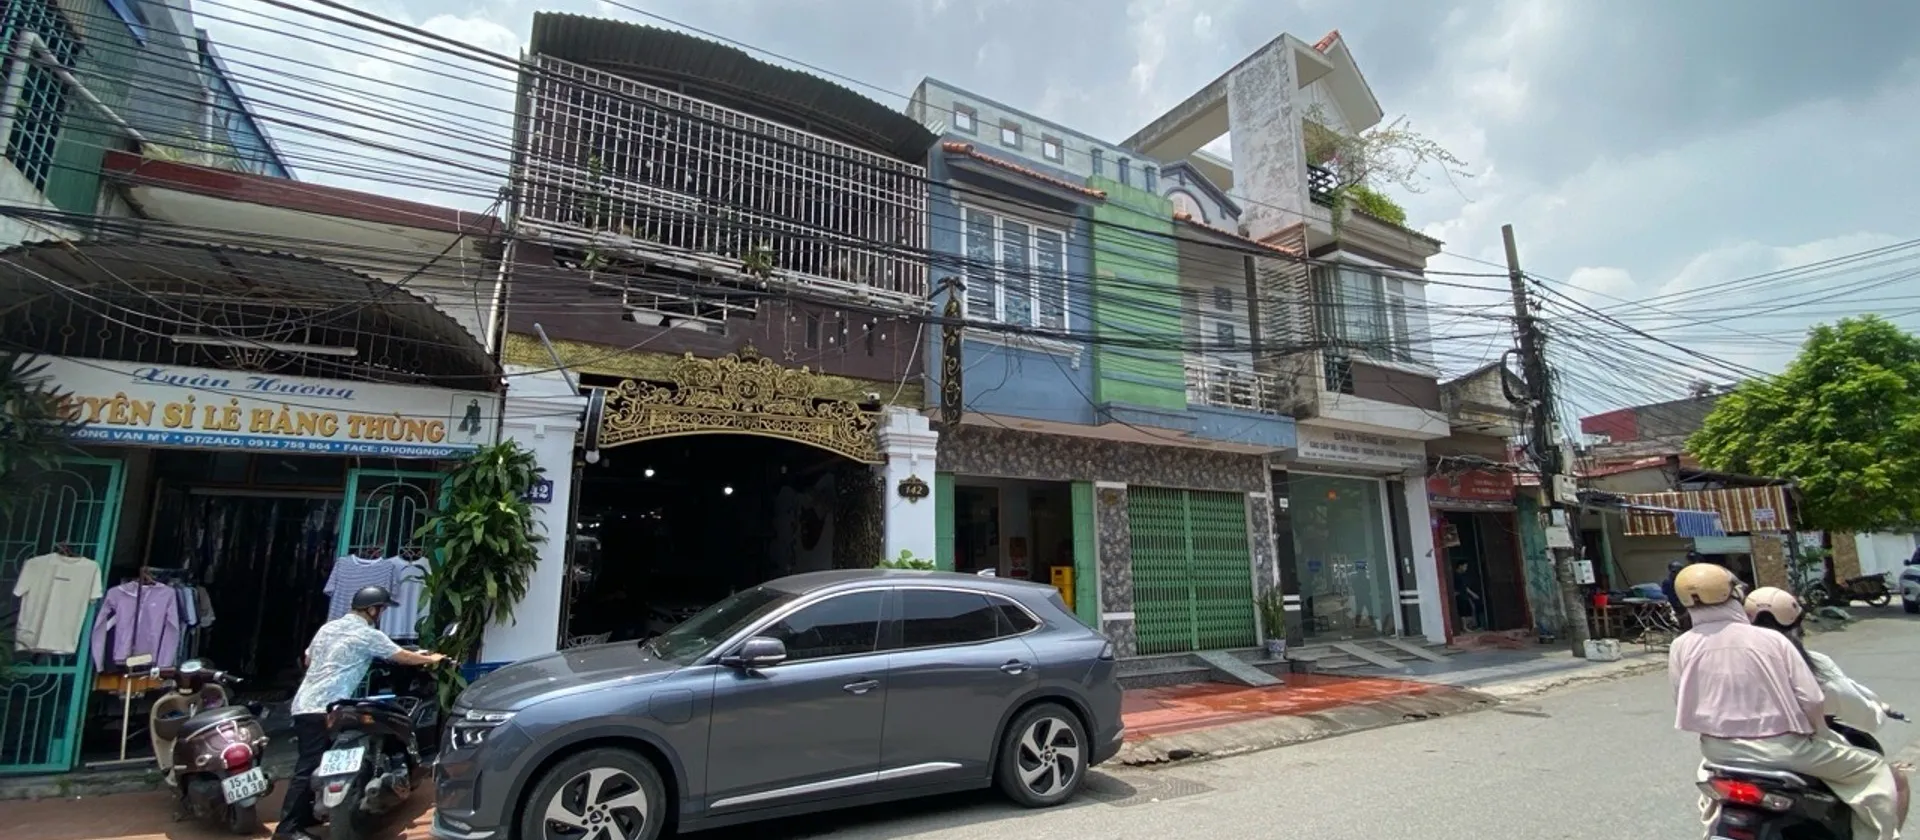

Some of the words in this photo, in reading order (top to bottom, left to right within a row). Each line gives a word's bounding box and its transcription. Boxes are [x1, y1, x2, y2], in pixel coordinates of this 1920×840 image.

[10, 391, 156, 428] UYÊN
[249, 403, 340, 438] HÀNG
[347, 411, 445, 443] THÙNG
[248, 439, 279, 448] 0912
